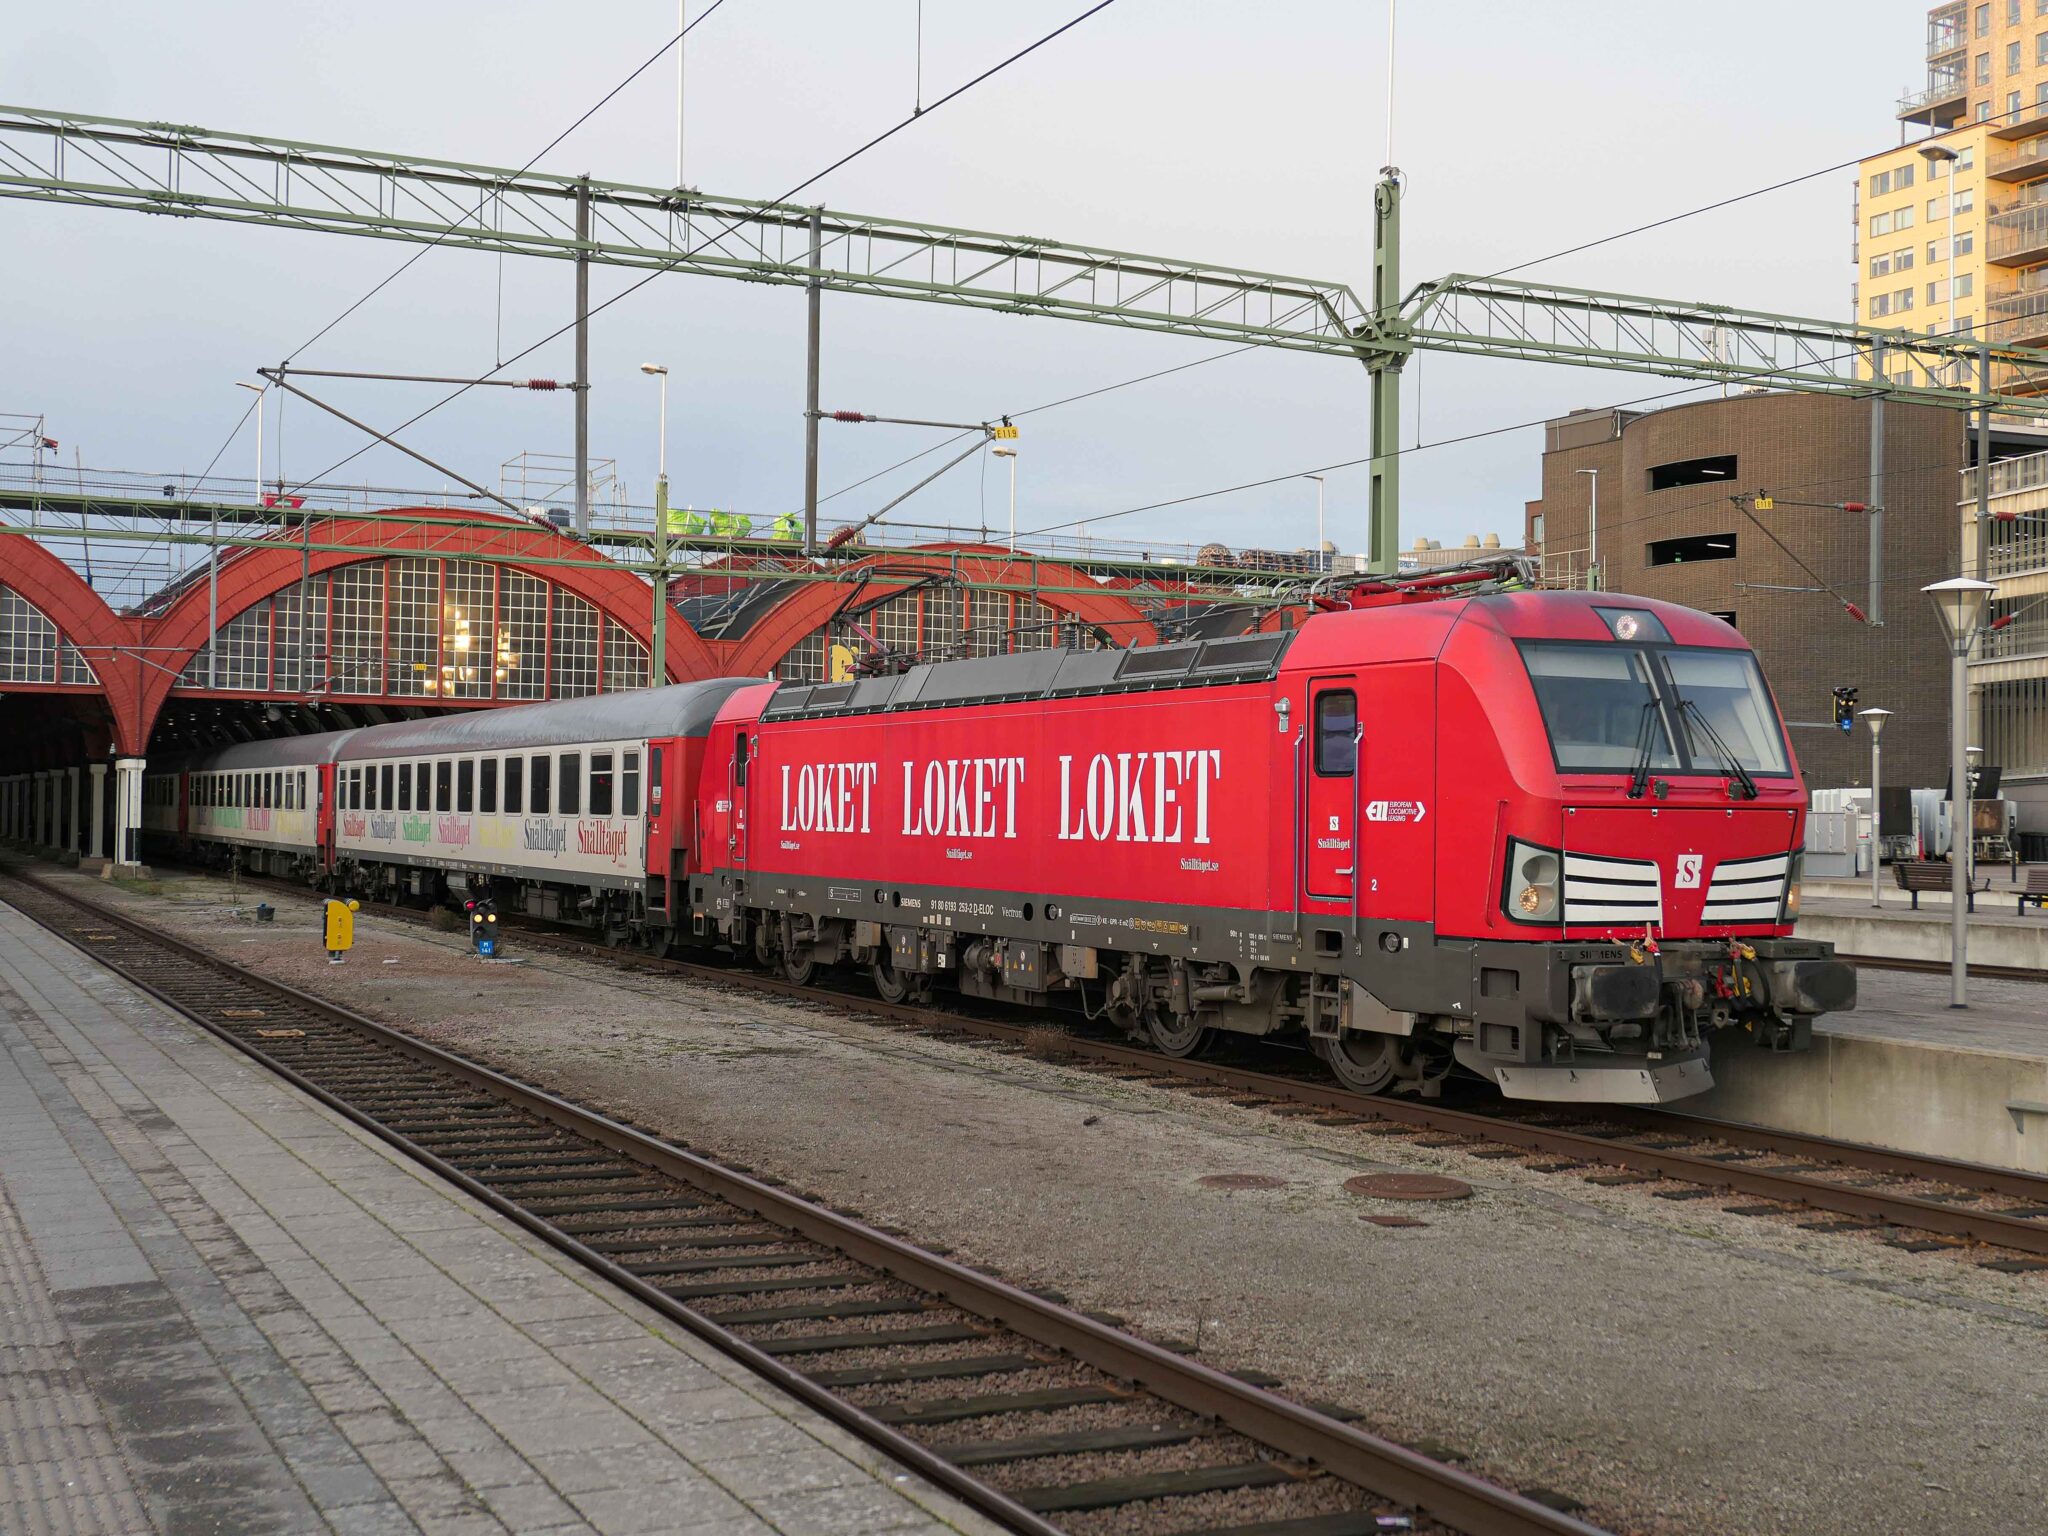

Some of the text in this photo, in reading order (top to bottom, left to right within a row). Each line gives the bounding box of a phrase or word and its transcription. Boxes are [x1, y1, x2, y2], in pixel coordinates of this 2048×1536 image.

[780, 762, 877, 834] LOKET
[901, 757, 1024, 839] LOKET
[1058, 749, 1220, 844] LOKET
[524, 819, 567, 859] Snälltåget
[577, 820, 627, 864] Snälltåget
[1318, 838, 1350, 850] Snälltåget
[1180, 857, 1219, 872] Snälltåget.se
[1682, 860, 1696, 883] S
[1371, 879, 1378, 891] 2
[900, 897, 921, 908] SIEMENS
[930, 899, 994, 916] 91 80 6193 253-2 D-ELOC
